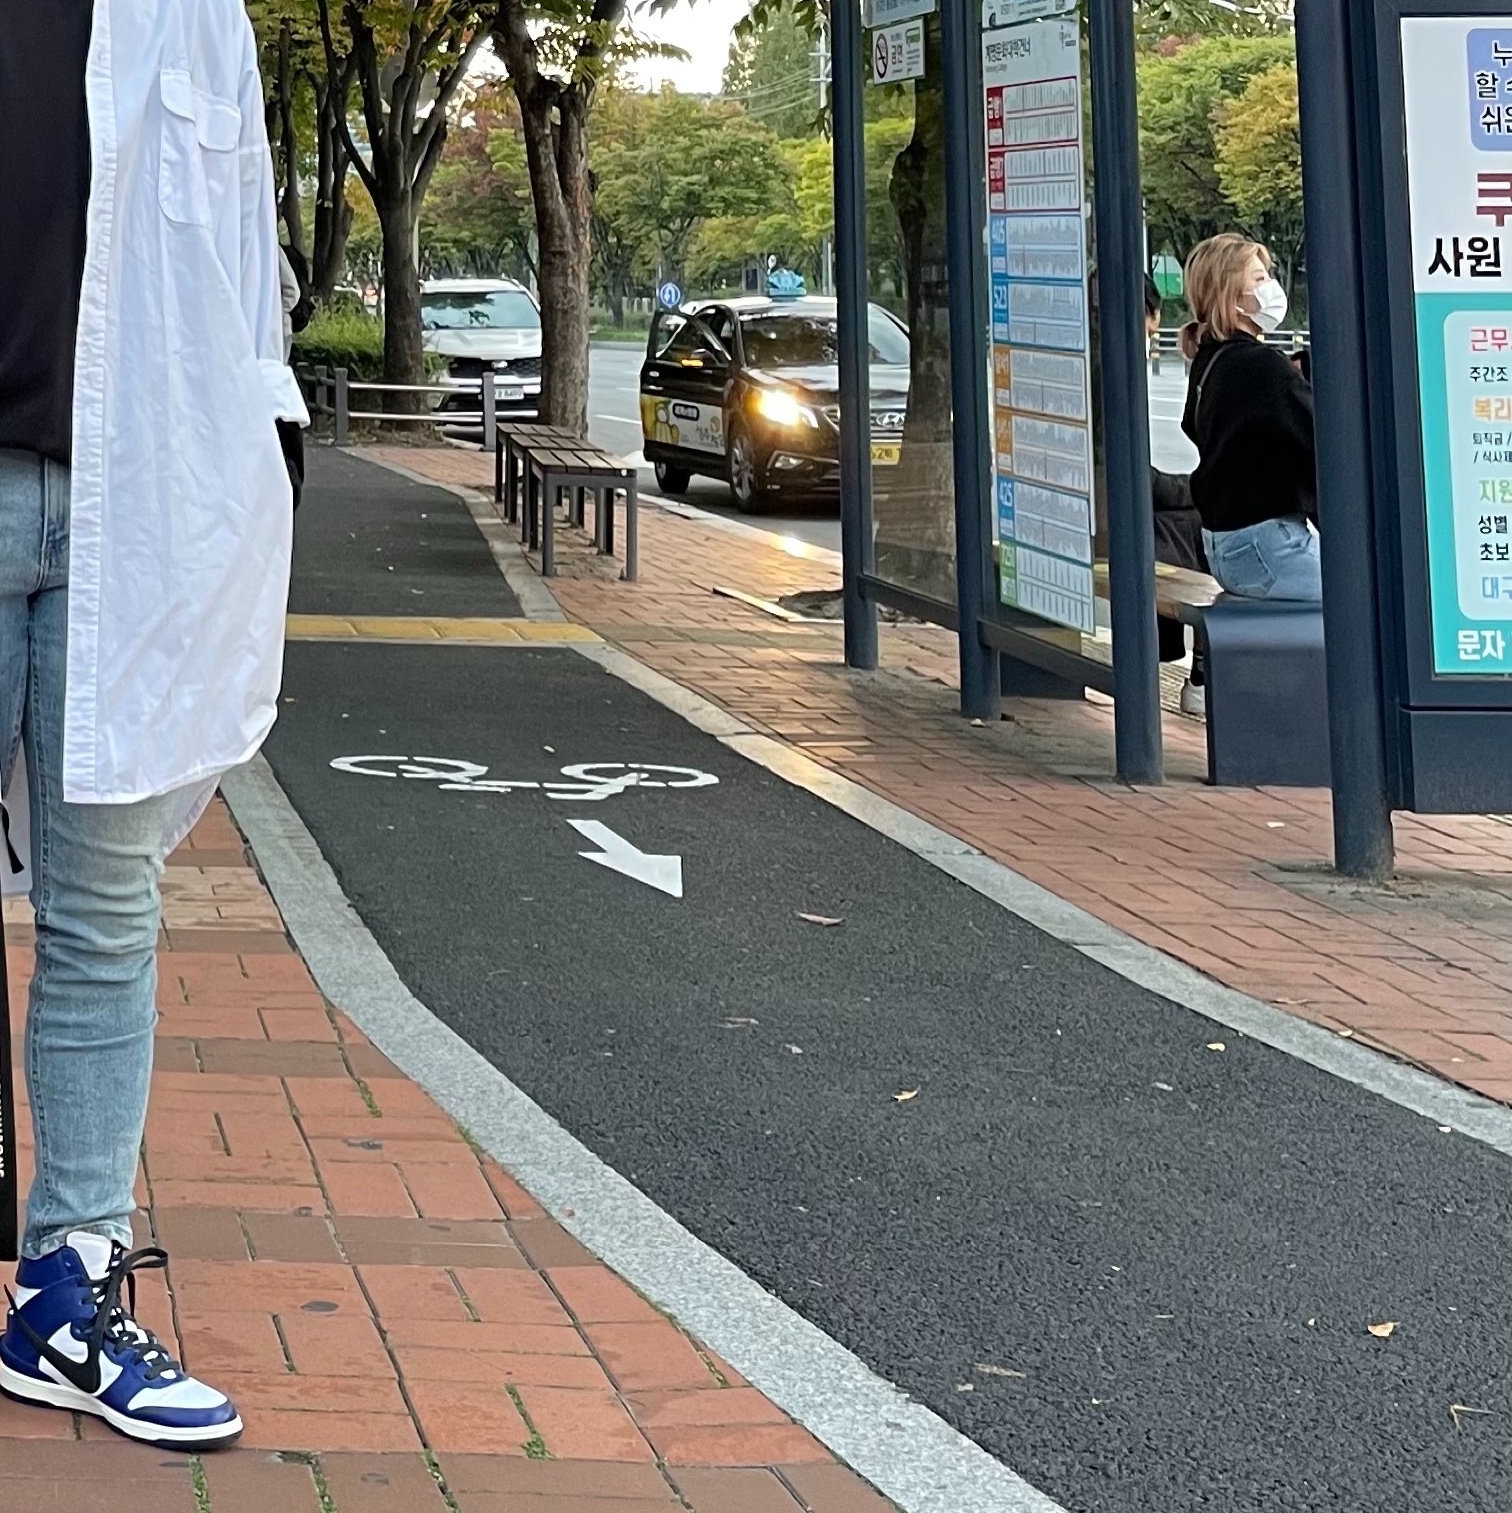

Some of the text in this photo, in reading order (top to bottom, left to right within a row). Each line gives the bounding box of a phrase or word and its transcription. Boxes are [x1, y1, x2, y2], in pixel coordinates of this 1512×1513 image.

[1476, 72, 1499, 99] 할
[1428, 236, 1502, 278] 사원
[1469, 366, 1509, 383] 주간조
[1478, 514, 1508, 534] 성별
[1457, 629, 1506, 661] 문자
